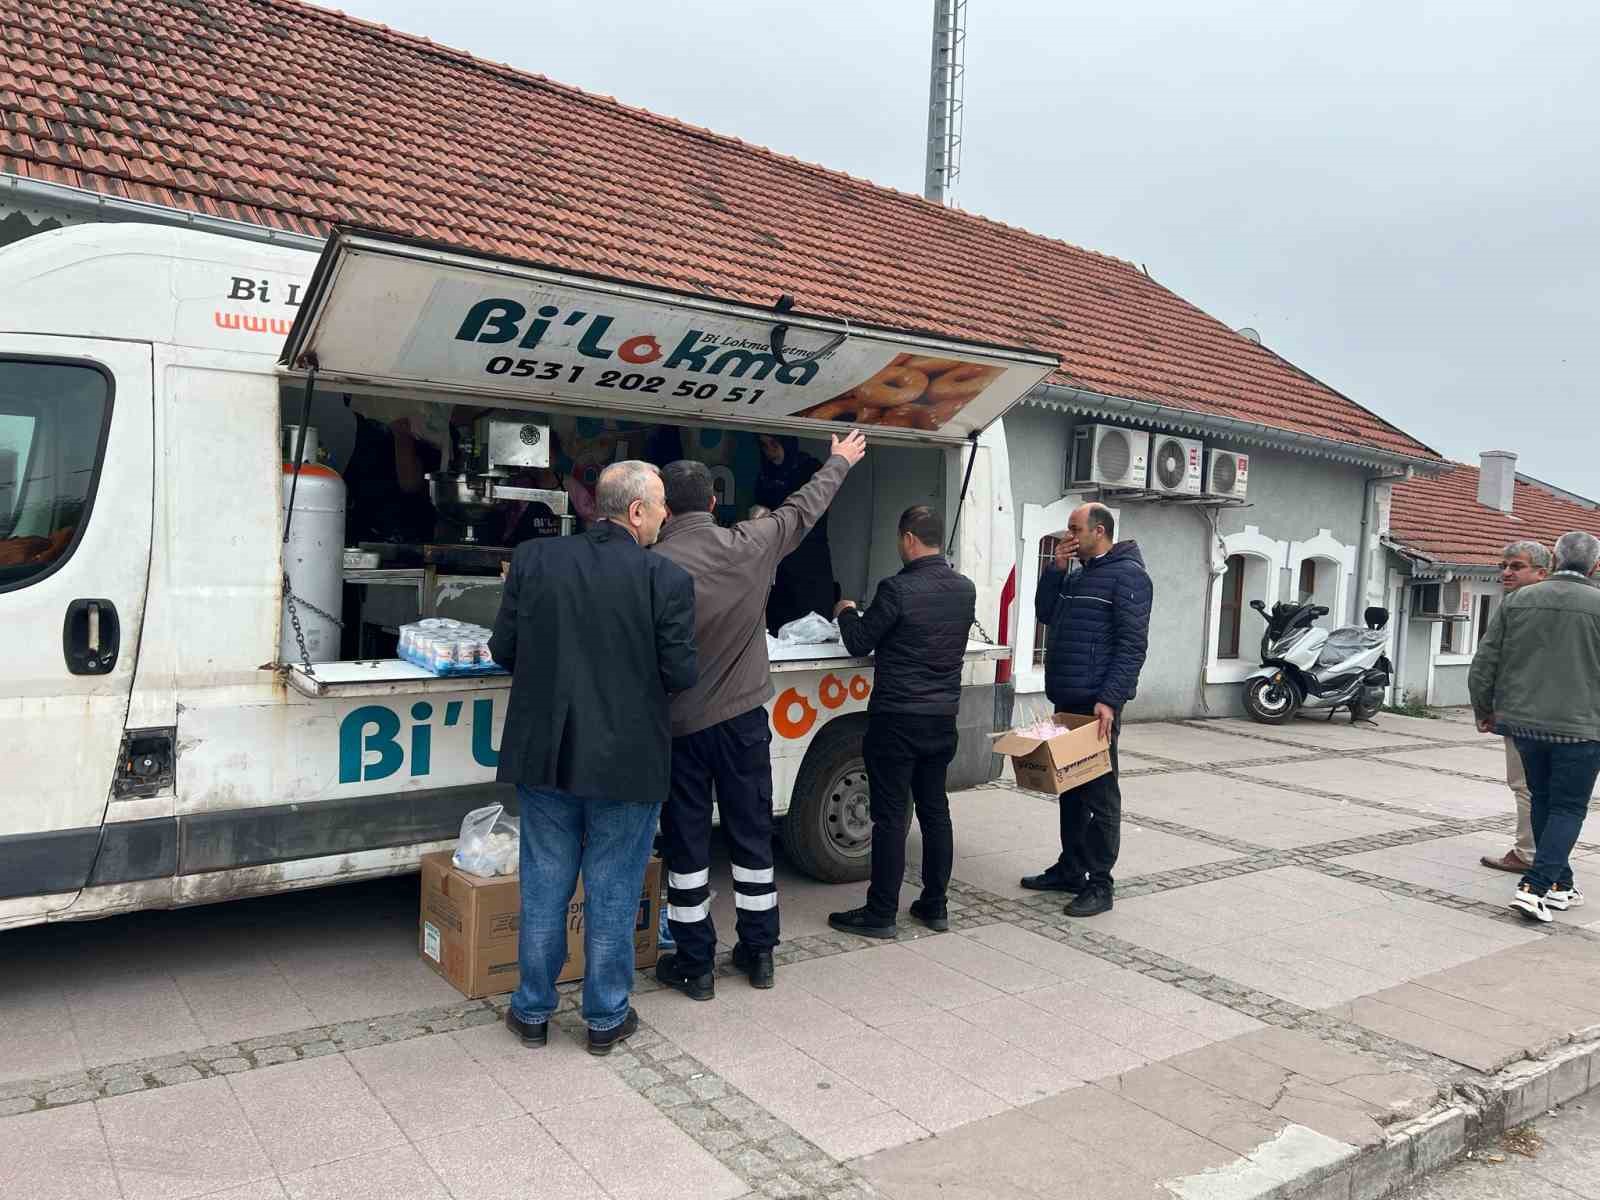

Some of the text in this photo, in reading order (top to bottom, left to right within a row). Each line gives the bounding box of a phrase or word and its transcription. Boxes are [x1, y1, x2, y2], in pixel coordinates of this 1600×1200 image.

[227, 276, 271, 303] Bi
[701, 333, 722, 344] Bi
[720, 335, 770, 352] Lokma
[485, 356, 766, 405] 0531 202 50 51
